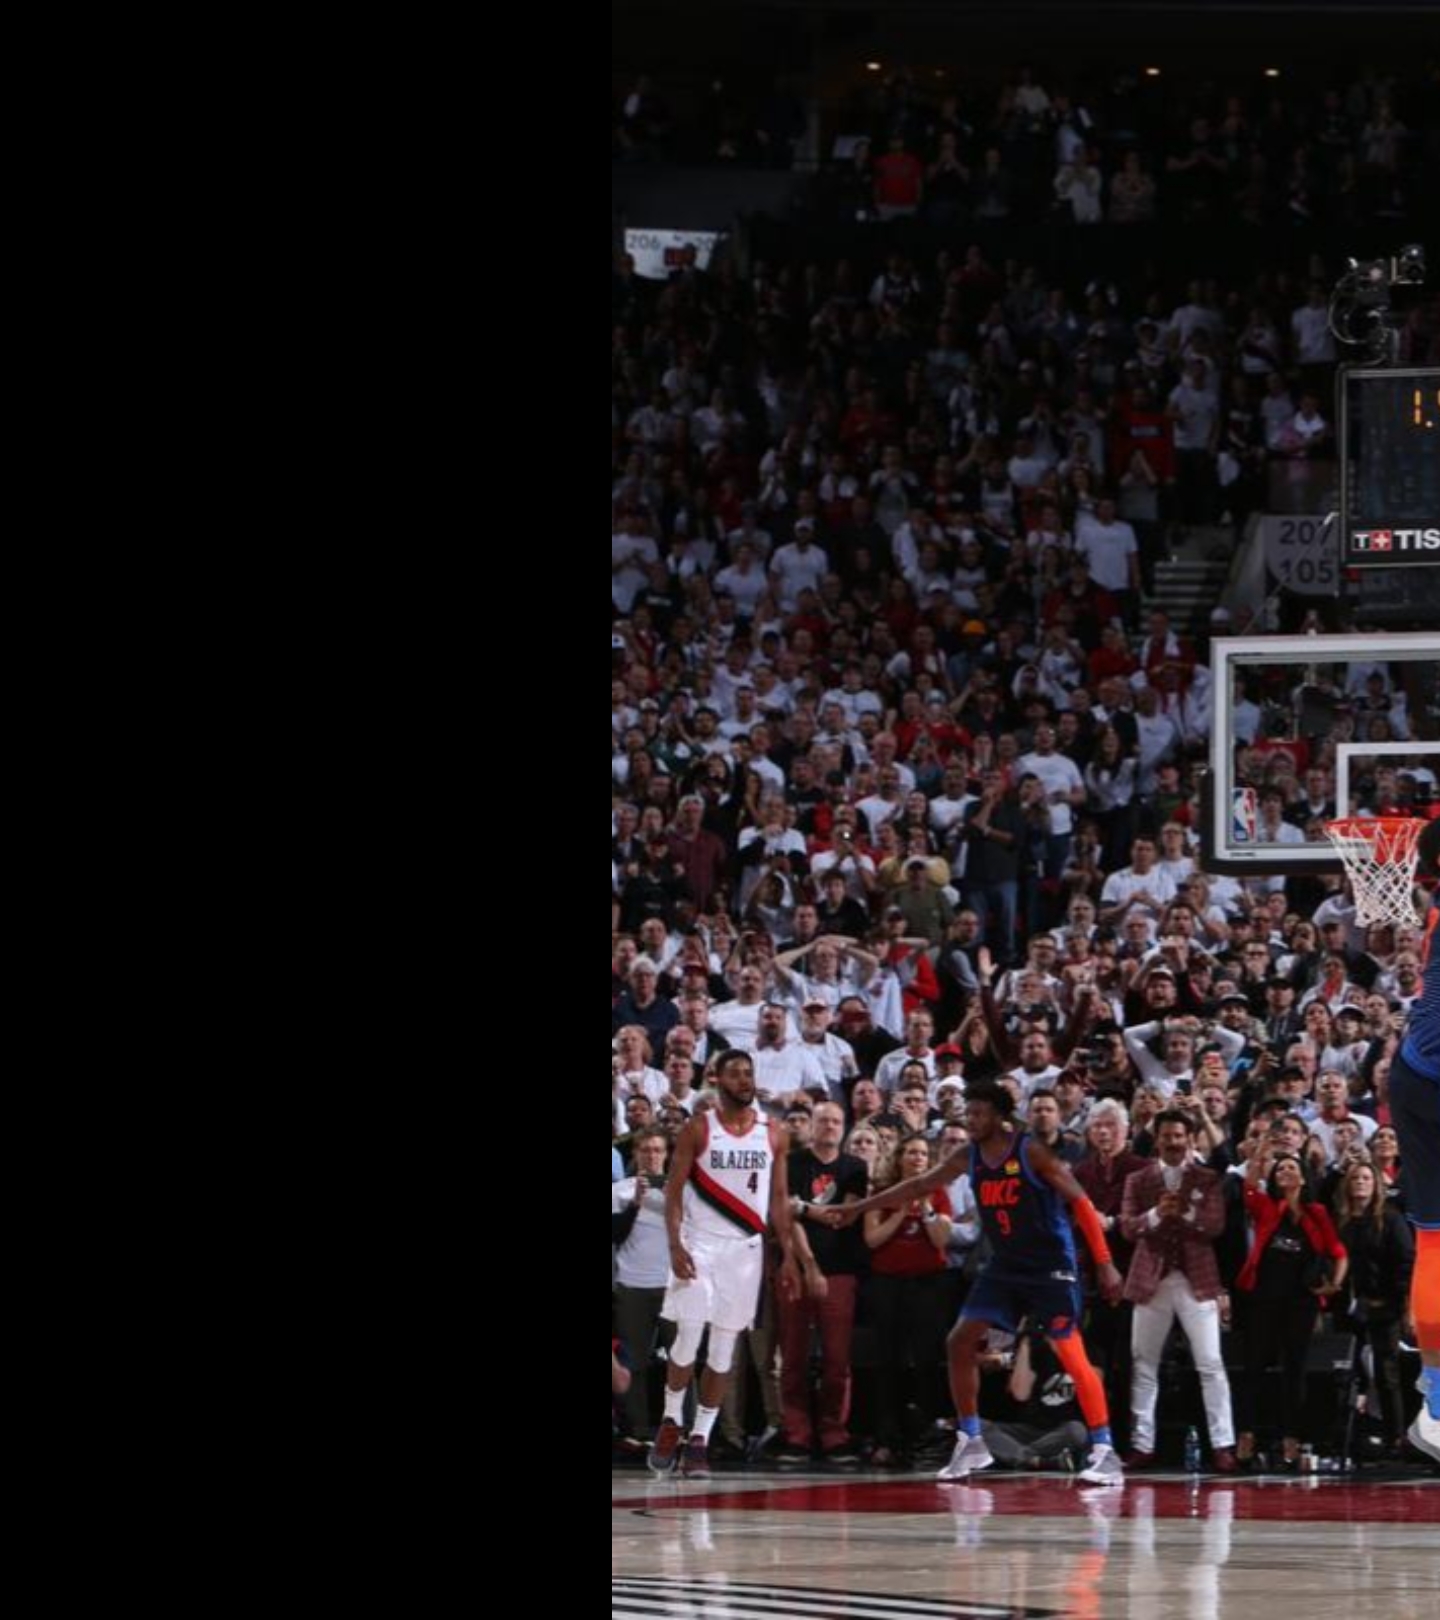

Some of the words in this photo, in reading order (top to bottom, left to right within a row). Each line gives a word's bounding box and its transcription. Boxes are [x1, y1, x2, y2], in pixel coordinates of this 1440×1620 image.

[1279, 520, 1333, 546] 207
[1280, 559, 1333, 584] 105
[710, 1149, 767, 1169] BLAZERS
[746, 1171, 759, 1194] 4
[980, 1178, 1020, 1206] OKC
[994, 1210, 1011, 1234] 9
